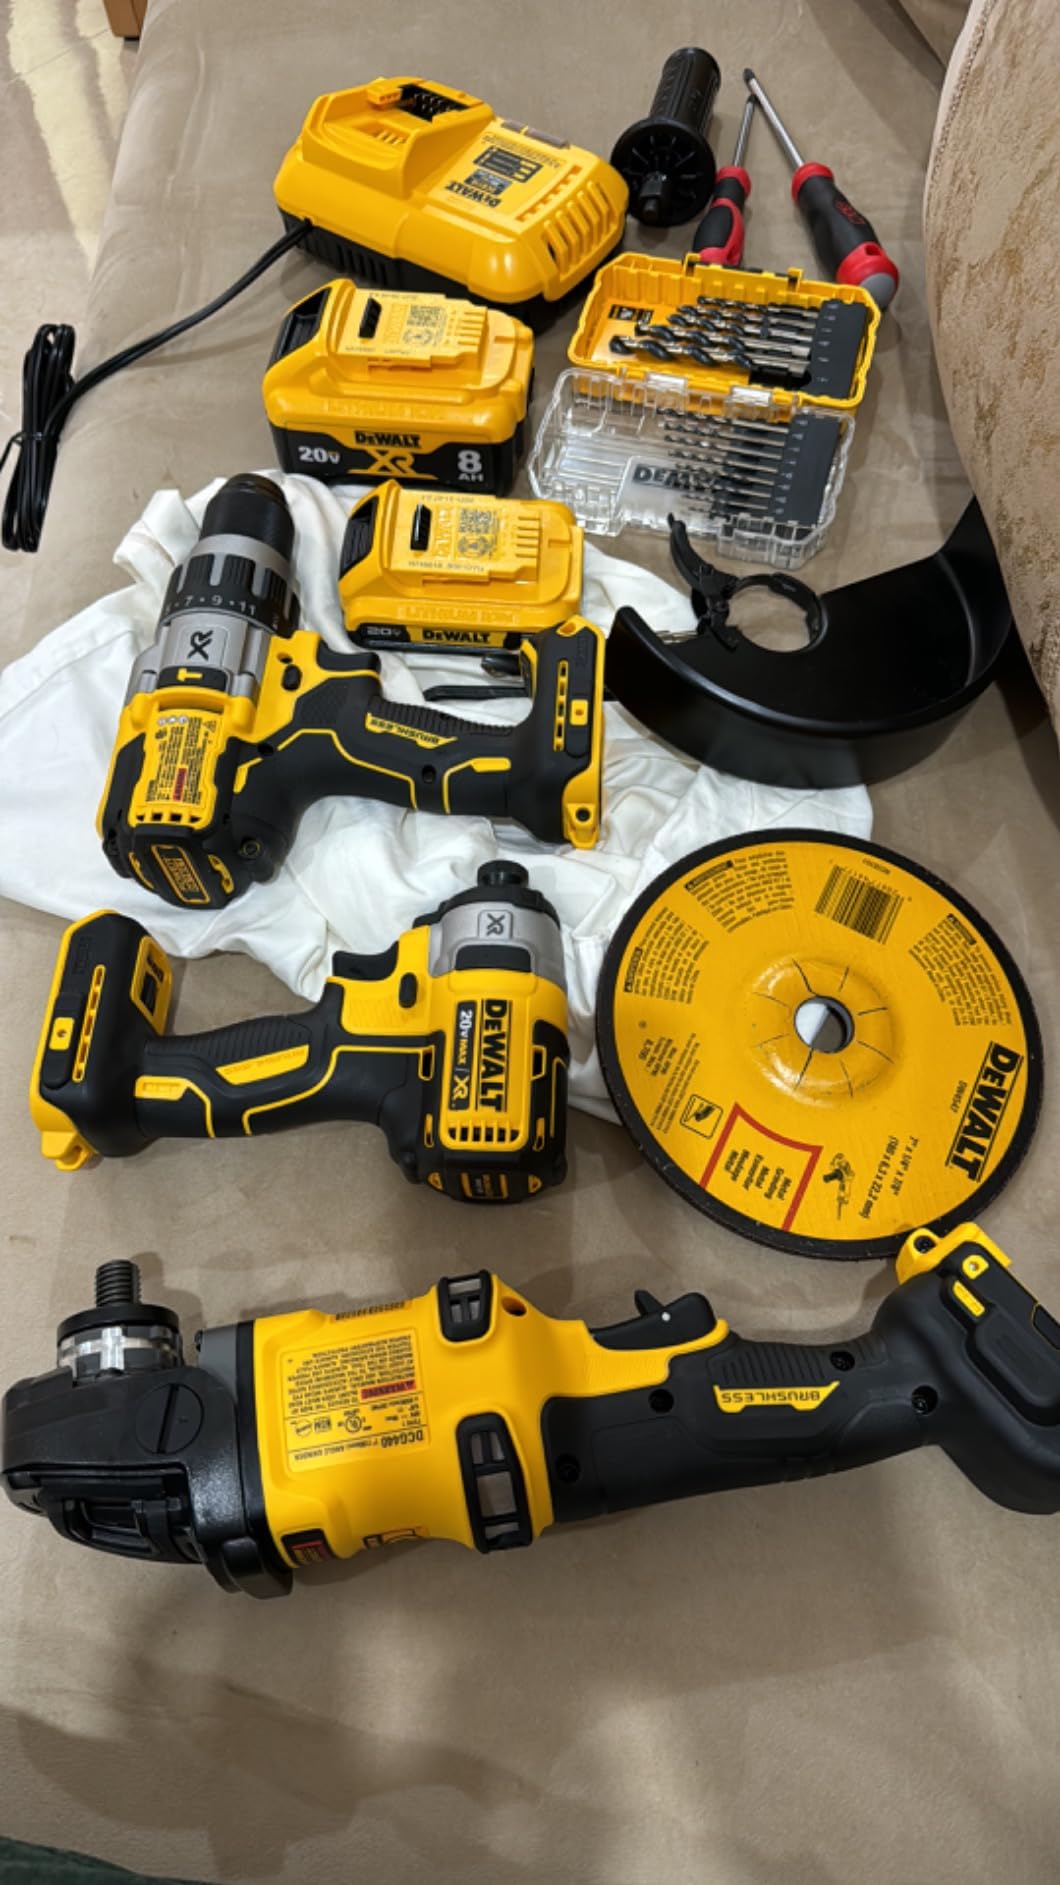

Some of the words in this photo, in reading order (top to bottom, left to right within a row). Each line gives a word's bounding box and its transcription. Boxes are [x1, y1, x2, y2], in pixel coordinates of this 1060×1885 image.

[457, 449, 482, 473] 8
[185, 596, 194, 606] 7
[211, 595, 223, 606] 9
[239, 601, 257, 616] 11
[721, 1390, 820, 1405] BRUSHLESS
